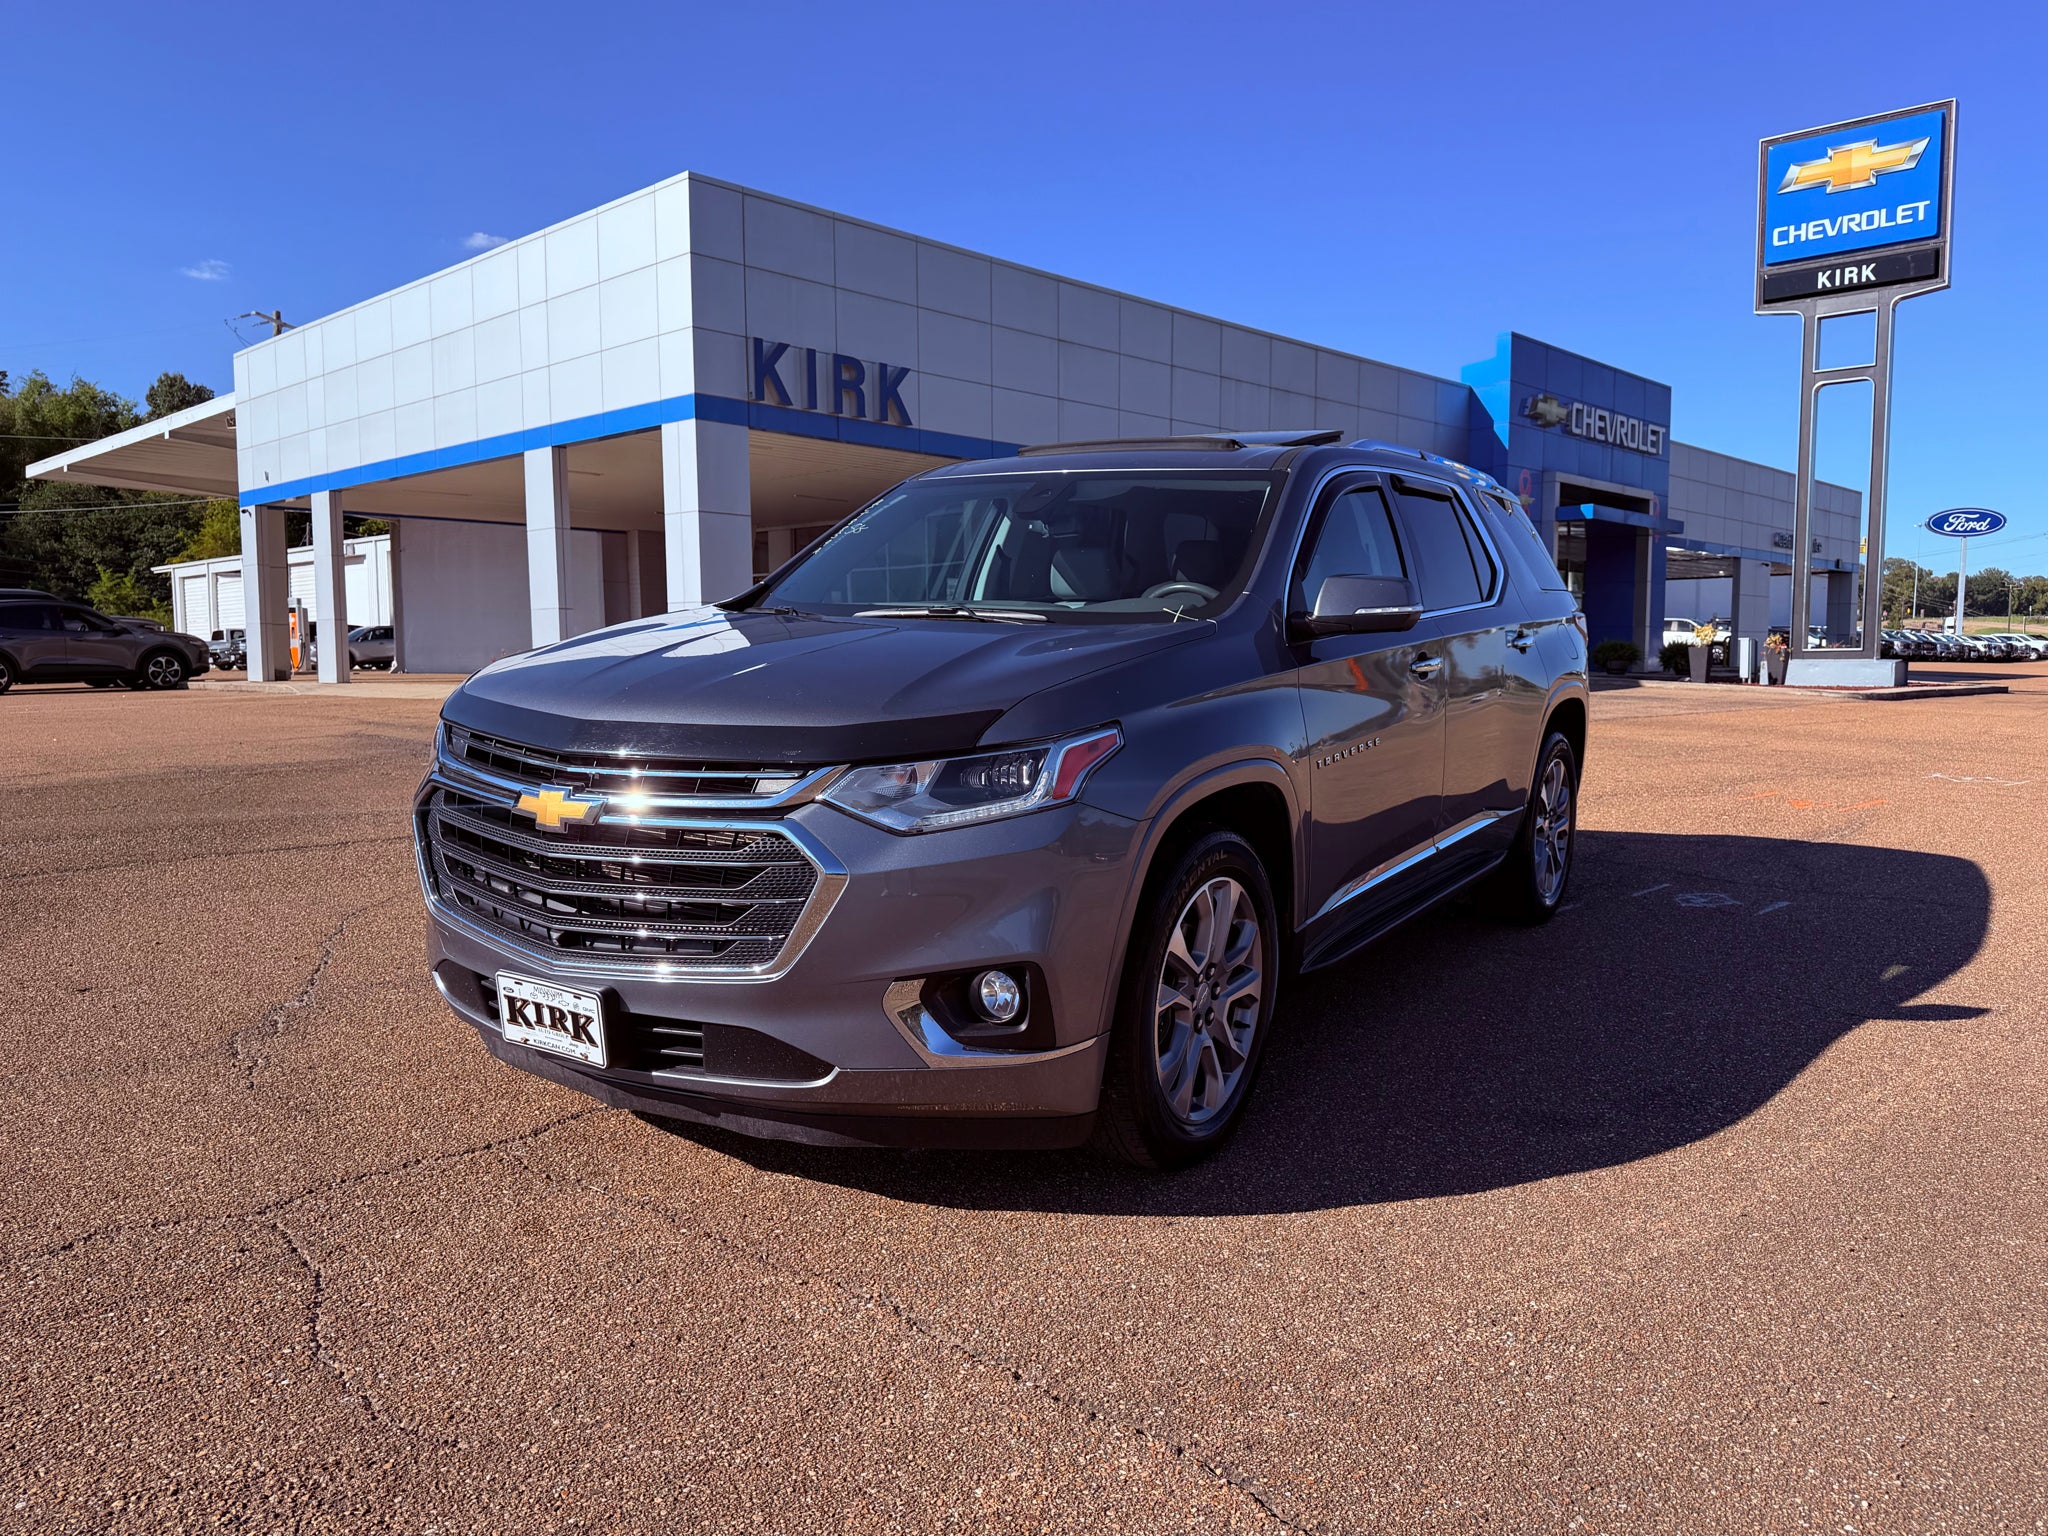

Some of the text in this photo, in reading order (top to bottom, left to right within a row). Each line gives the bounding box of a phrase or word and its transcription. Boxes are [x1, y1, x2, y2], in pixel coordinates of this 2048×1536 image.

[1772, 200, 1931, 247] CHEVROLET
[1817, 263, 1877, 289] KIRK
[753, 337, 914, 426] KIRK
[1571, 402, 1666, 455] CHEVROLET
[1943, 513, 1992, 532] Ford
[1316, 737, 1381, 769] TRAVERSE
[503, 994, 599, 1048] KIRK
